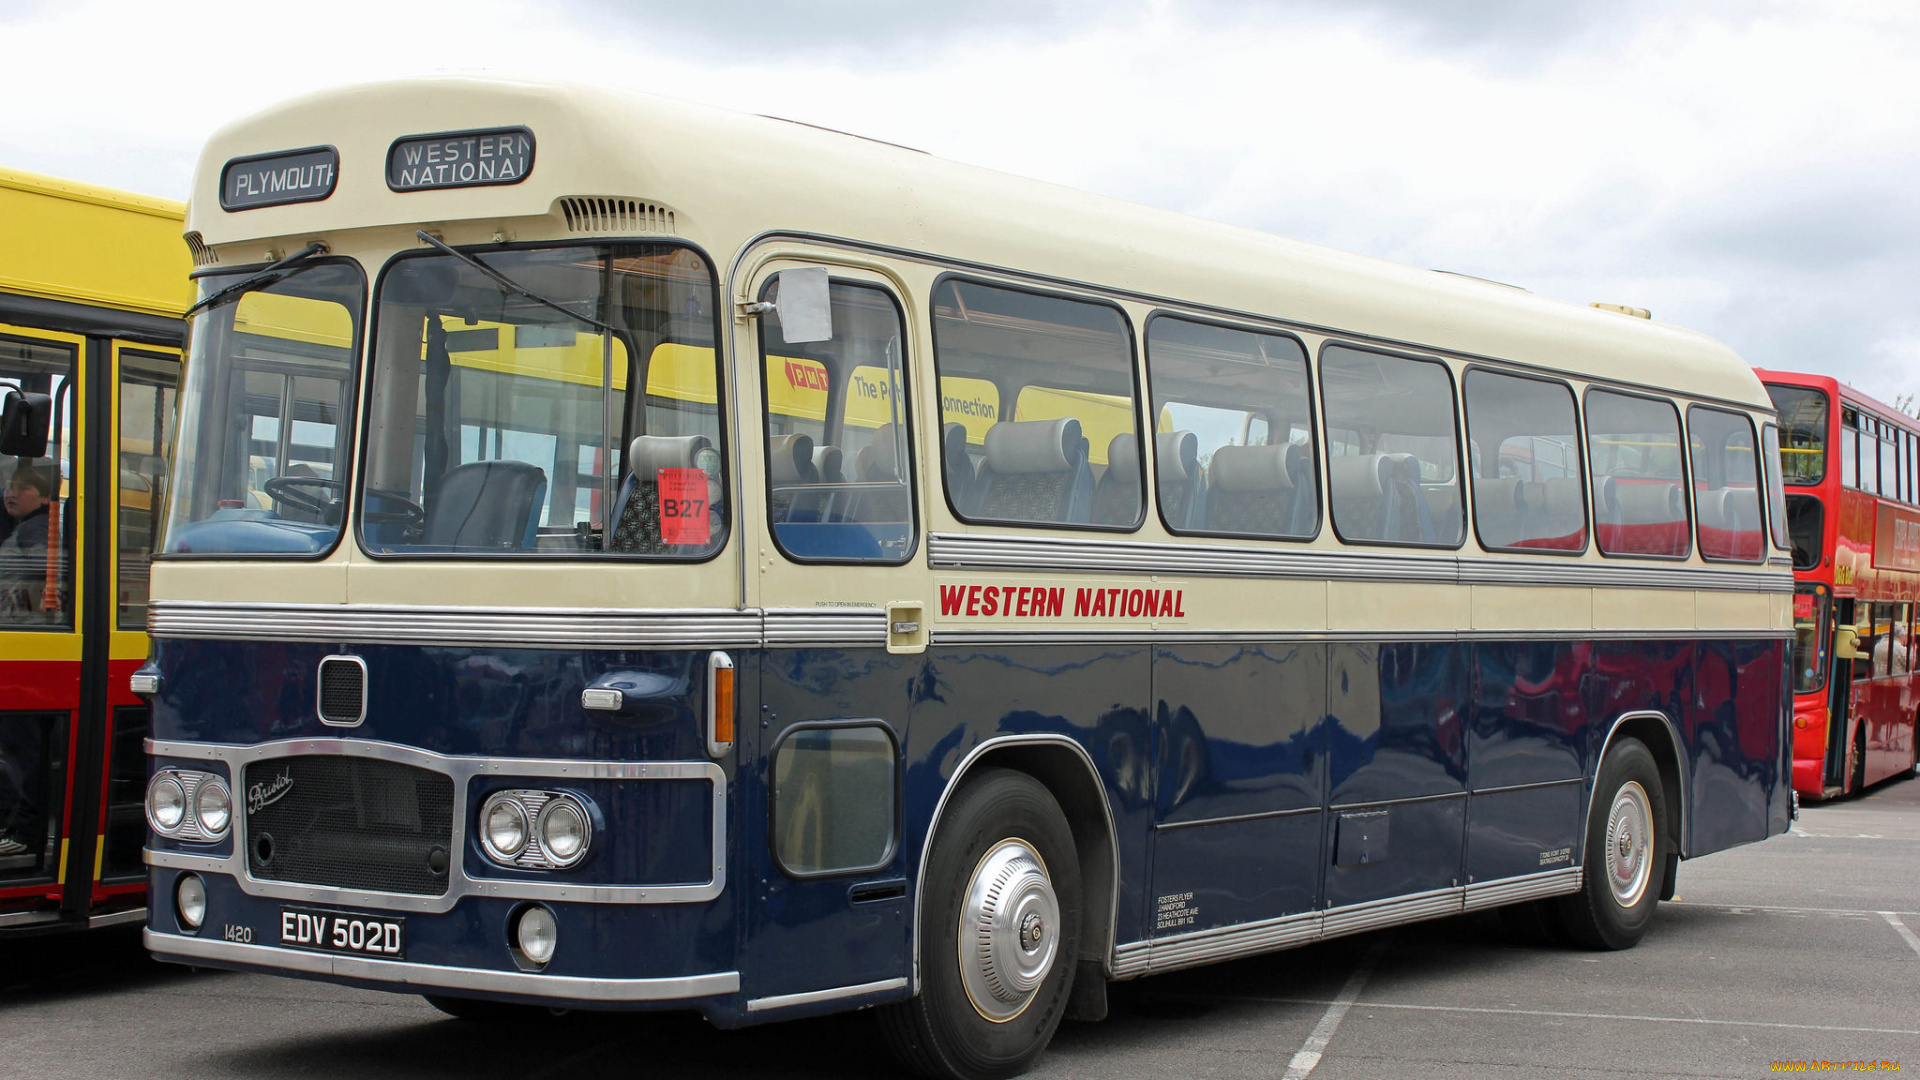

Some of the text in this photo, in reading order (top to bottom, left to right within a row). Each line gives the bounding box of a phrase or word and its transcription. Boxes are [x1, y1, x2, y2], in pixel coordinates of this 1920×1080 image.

[854, 376, 878, 399] The
[664, 499, 705, 518] B27
[940, 585, 1185, 618] WESTERN NATIONAL
[248, 765, 294, 815] Bristol
[1158, 892, 1193, 904] FOSTERS FLYER
[1163, 908, 1190, 919] HEATHCOTE
[1190, 907, 1199, 915] AVE
[224, 924, 252, 944] 1420
[282, 911, 401, 954] EDV 502D
